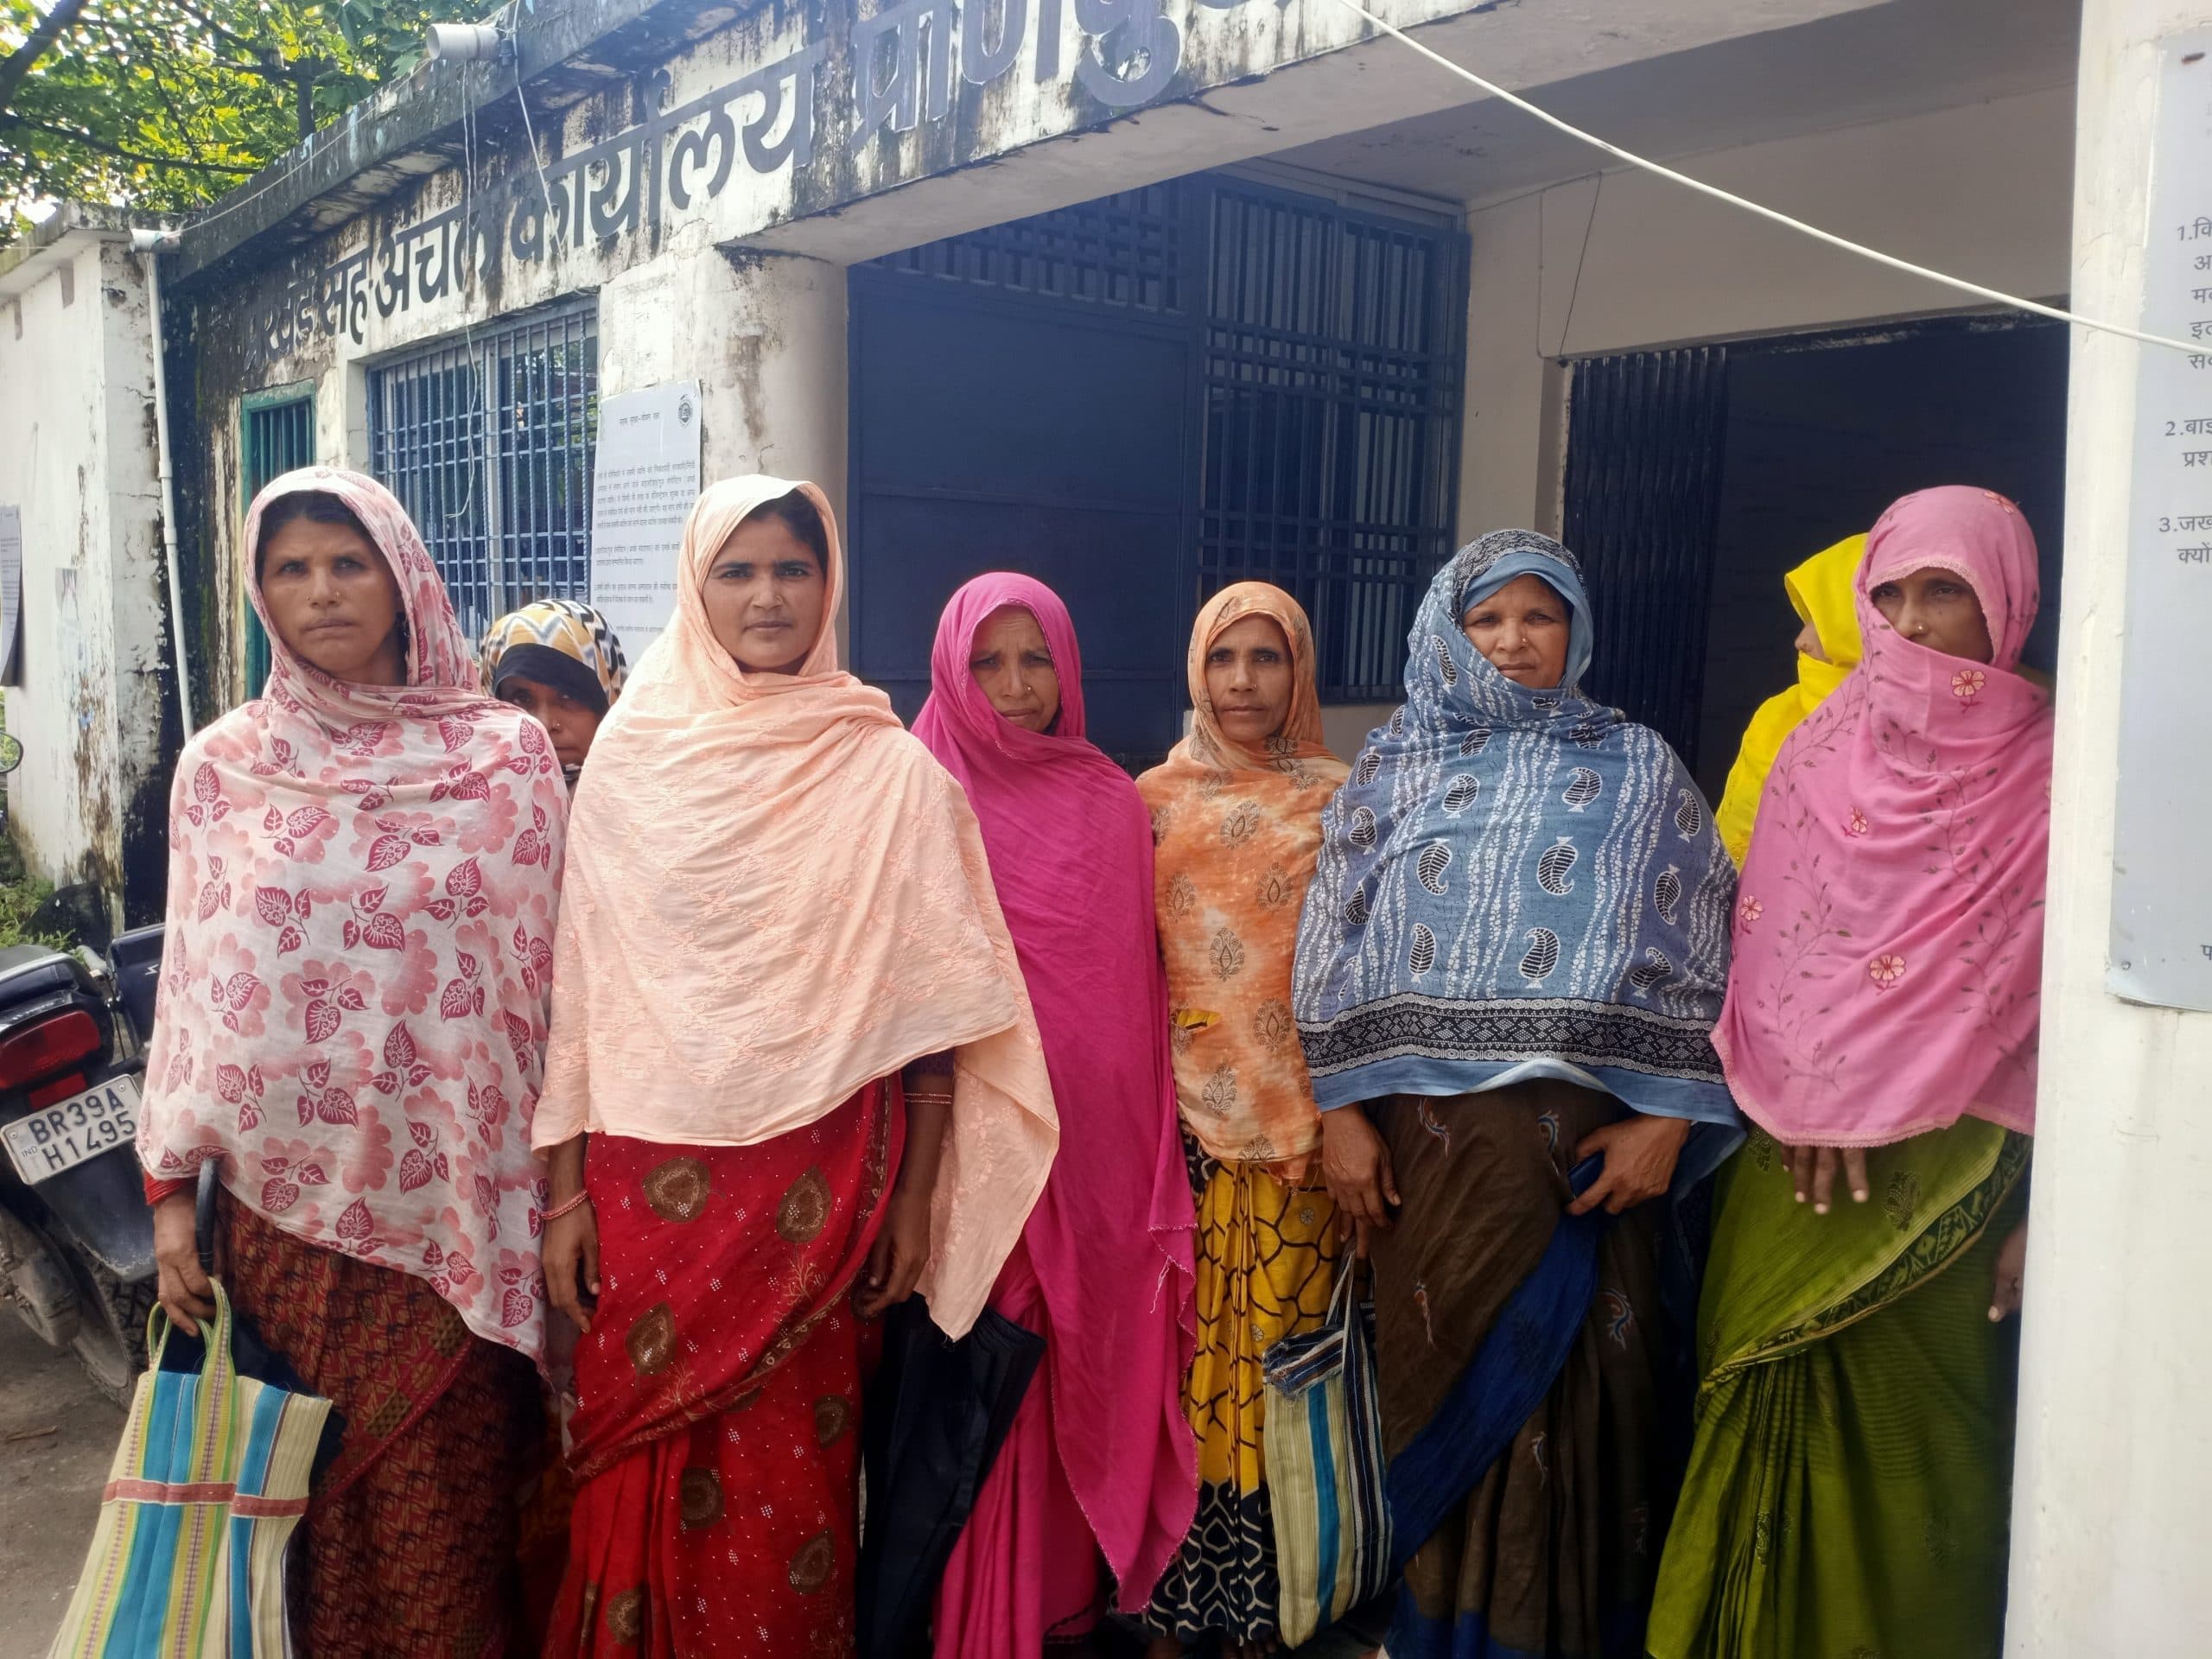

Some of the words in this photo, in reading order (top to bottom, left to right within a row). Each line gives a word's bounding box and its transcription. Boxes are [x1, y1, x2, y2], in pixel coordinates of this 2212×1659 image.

[510, 40, 827, 261] कार्यालय
[28, 1088, 124, 1145] BR39A
[41, 1111, 136, 1170] H1495
[22, 1146, 38, 1158] IND
